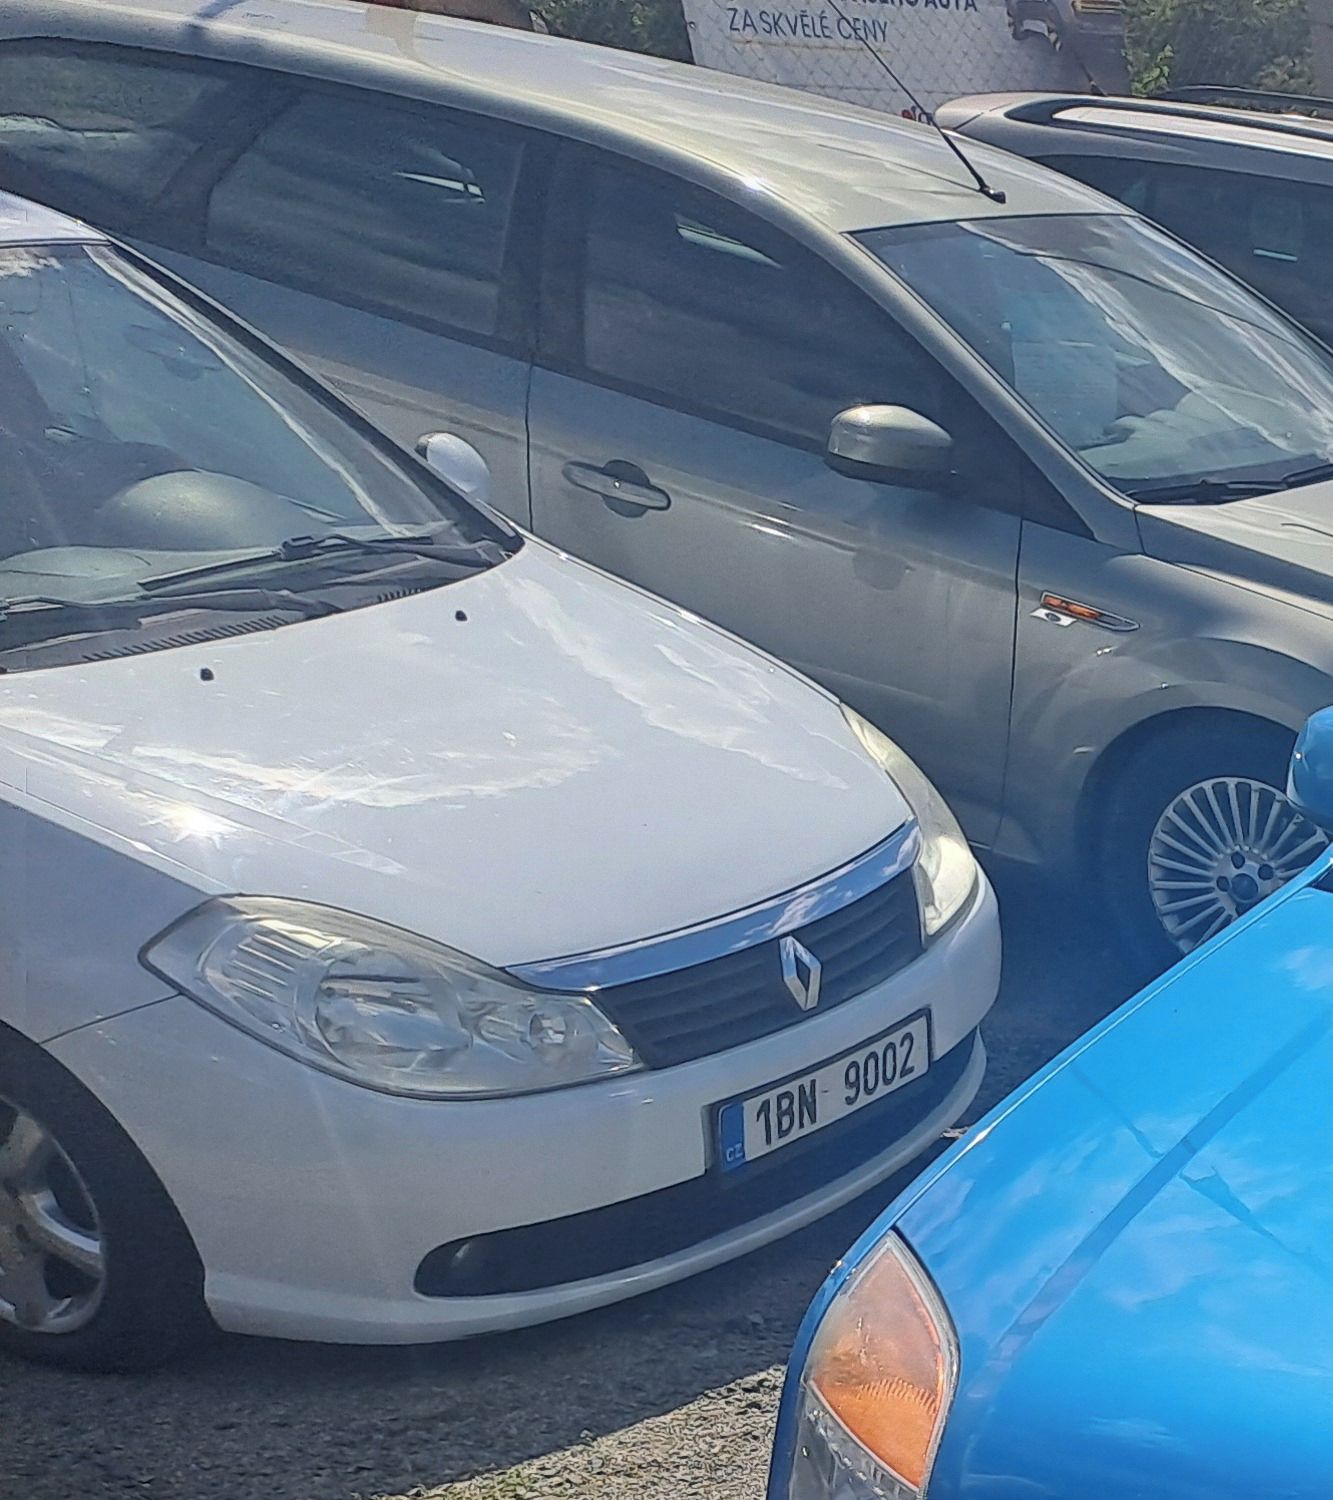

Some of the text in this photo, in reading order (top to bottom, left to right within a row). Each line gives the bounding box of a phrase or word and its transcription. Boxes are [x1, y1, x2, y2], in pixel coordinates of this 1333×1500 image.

[837, 16, 888, 43] CENY
[726, 1032, 914, 1162] CZ 1BN 9002
